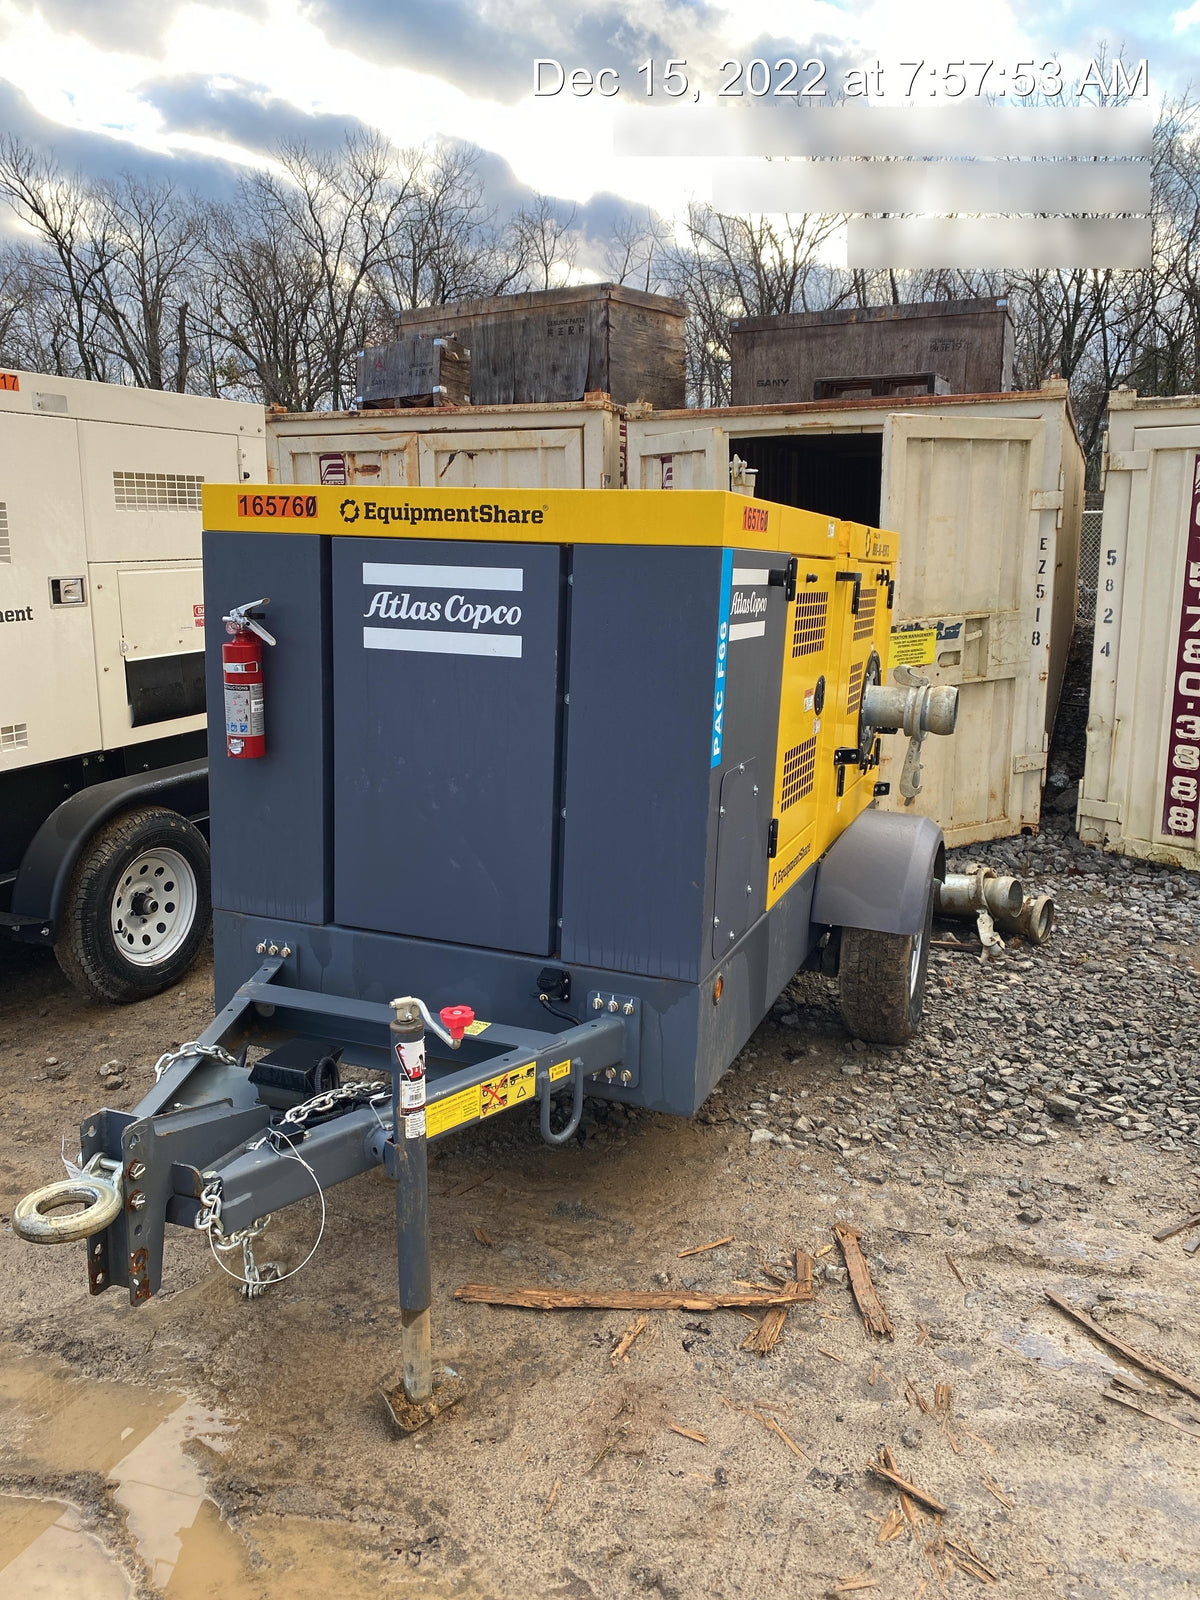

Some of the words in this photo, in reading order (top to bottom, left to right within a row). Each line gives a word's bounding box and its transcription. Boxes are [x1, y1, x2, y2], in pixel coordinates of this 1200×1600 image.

[756, 378, 789, 388] SANY
[238, 495, 317, 517] 165760
[363, 501, 544, 525] EquipmentShare
[743, 506, 769, 532] 165760
[363, 591, 442, 621] Atlas
[444, 594, 522, 629] Copco
[730, 591, 750, 615] Atlas
[749, 591, 768, 617] Copco
[717, 621, 727, 679] F66
[713, 690, 724, 756] PAC
[777, 842, 811, 884] EquipmentShare
